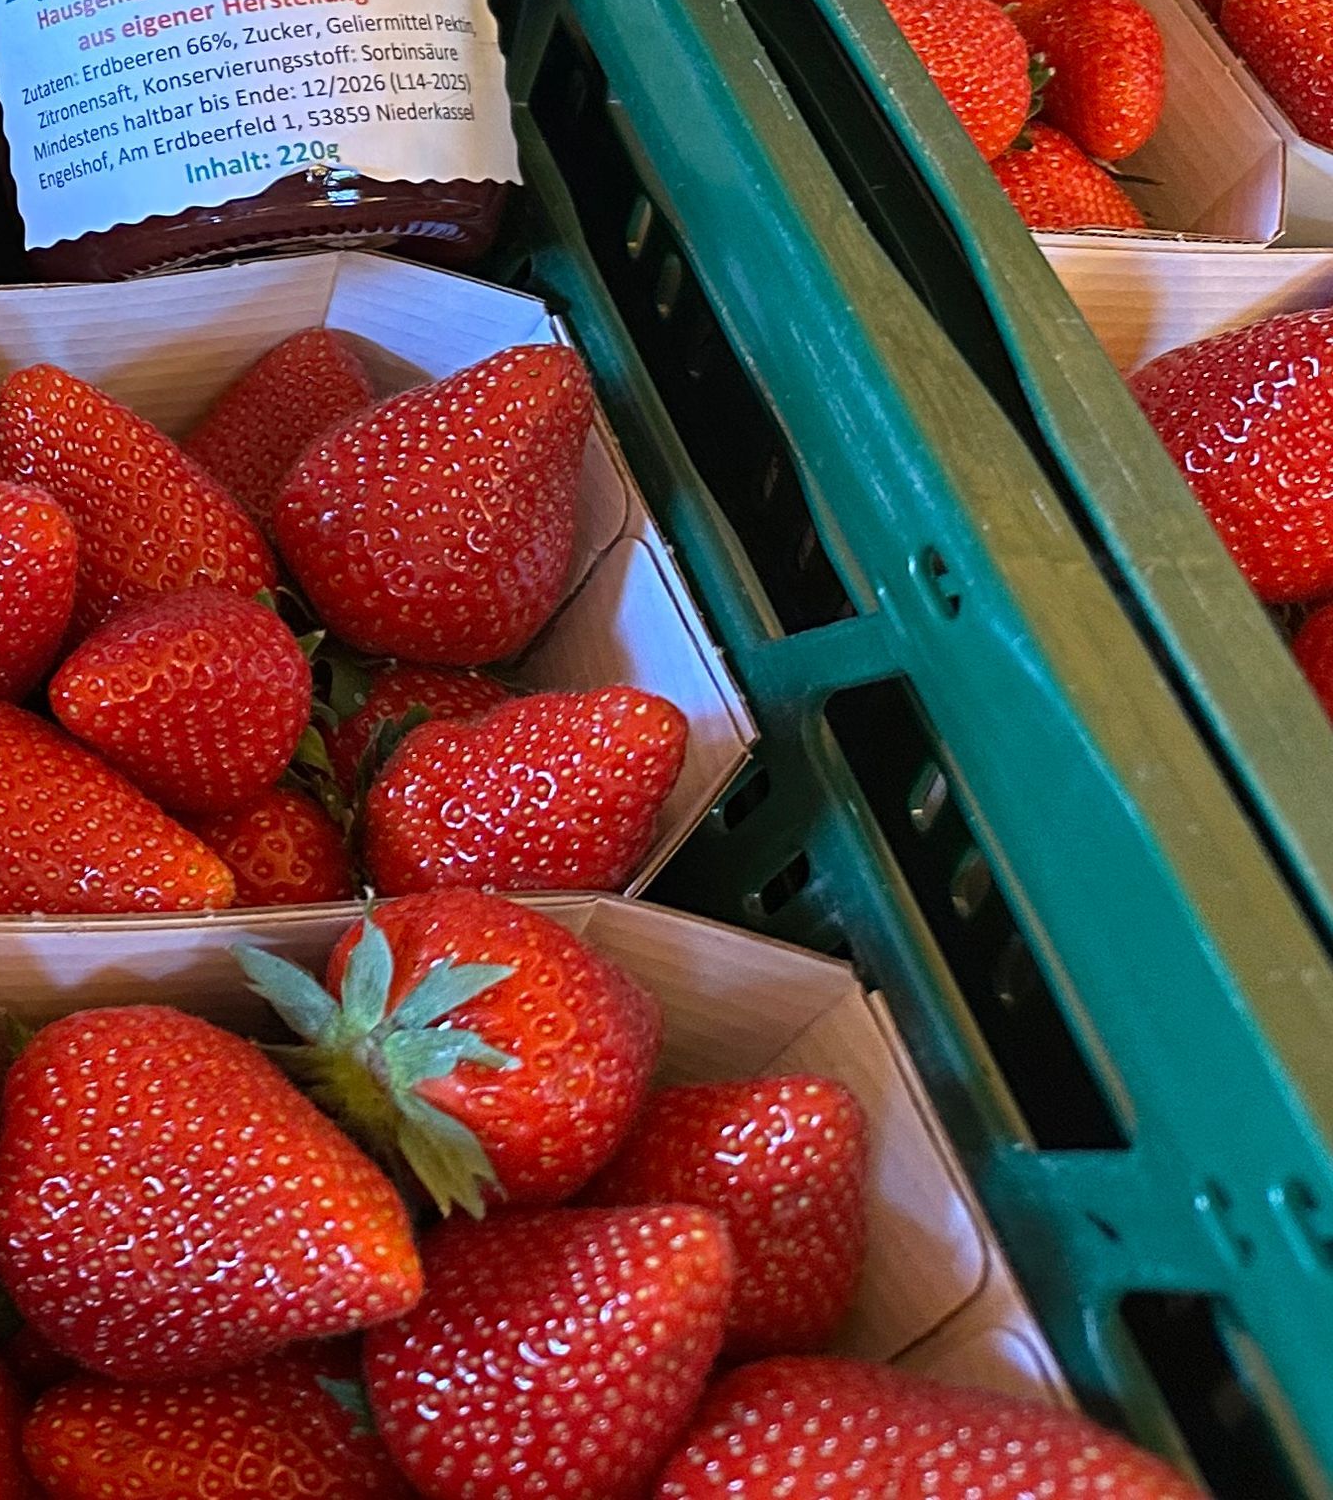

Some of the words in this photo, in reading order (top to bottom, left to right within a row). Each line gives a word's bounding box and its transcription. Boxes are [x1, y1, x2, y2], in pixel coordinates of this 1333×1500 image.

[22, 72, 80, 106] Zutaten:
[82, 44, 181, 82] Erdbeeren
[186, 31, 238, 56] 66%,
[243, 22, 321, 44] Zucker,
[326, 14, 432, 34] Geliermittel
[77, 27, 116, 51] aus
[122, 4, 215, 38] eigener
[33, 121, 119, 161] Mindestens
[123, 102, 194, 133] haltbar
[200, 94, 230, 114] bis
[236, 84, 295, 107] Ende:
[302, 73, 386, 99] 12/2026
[390, 72, 472, 95] (L14-2025)
[38, 83, 139, 130] Zitronensaft,
[143, 45, 358, 96] Konservierungsstoff:
[361, 42, 459, 62] Sorbinsäure
[39, 150, 115, 190] Engelshof,
[118, 145, 149, 165] Am
[154, 117, 277, 155] Erdbeerfeld
[282, 112, 303, 131] 1,
[308, 104, 371, 127] 53859
[375, 101, 475, 122] Niederkassel
[185, 150, 271, 184] Inhalt:
[276, 140, 341, 167] 220g
